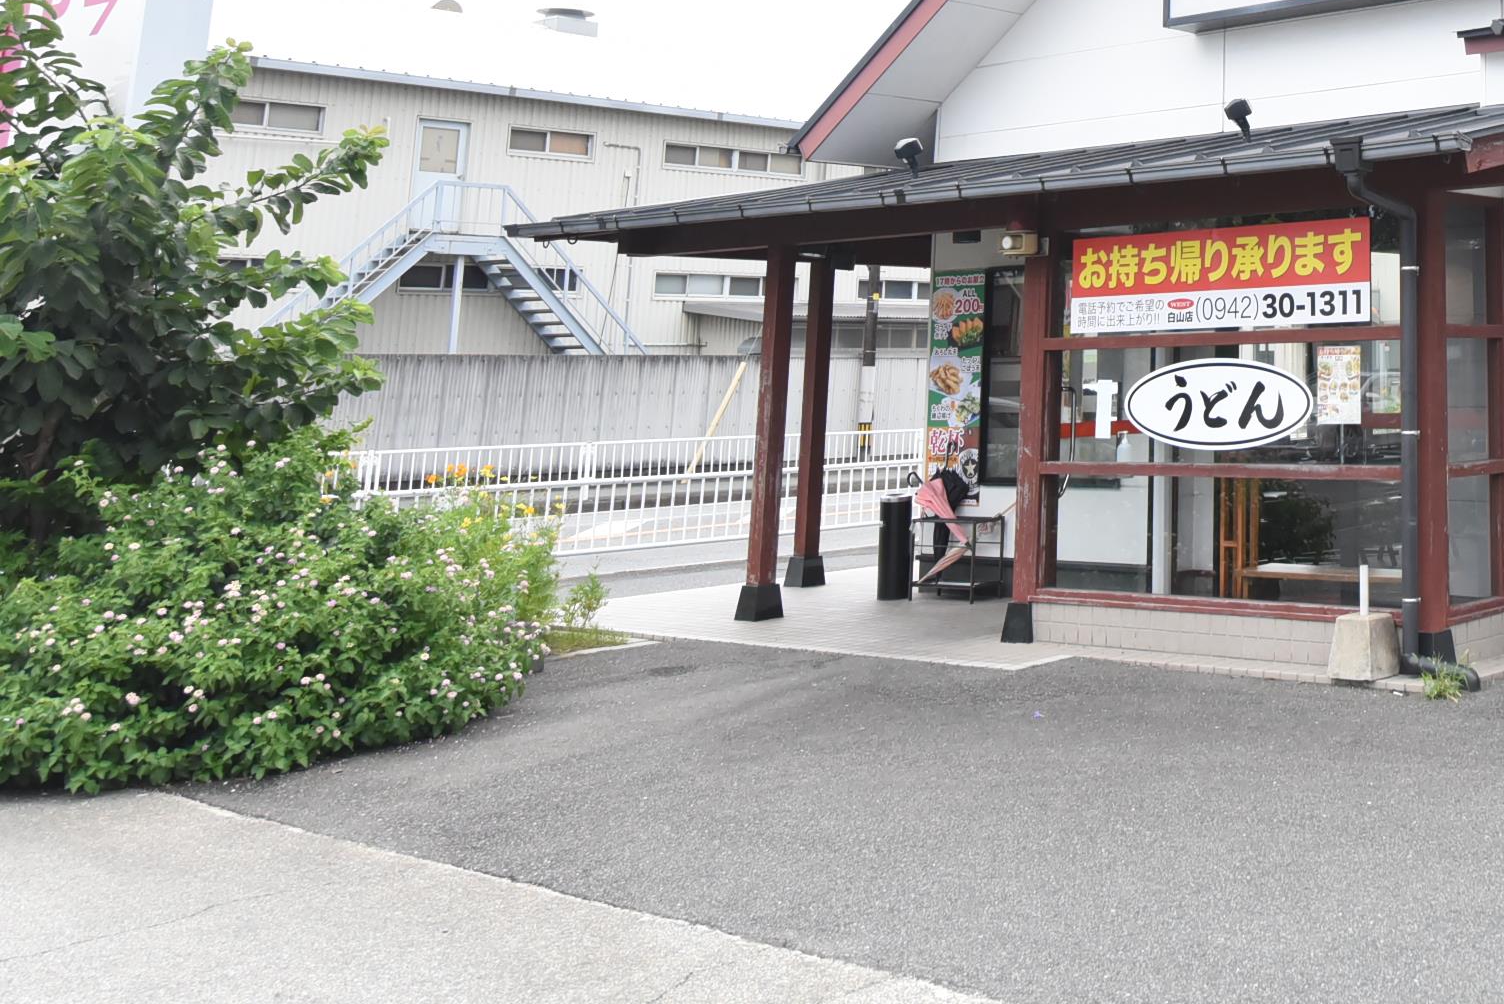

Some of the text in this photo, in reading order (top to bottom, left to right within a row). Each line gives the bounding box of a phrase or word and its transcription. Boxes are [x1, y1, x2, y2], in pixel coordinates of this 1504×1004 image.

[1077, 227, 1362, 290] お持ち帰り承ります
[962, 289, 976, 298] ALL
[1077, 298, 1165, 316] 電話予約でご希望の
[1167, 311, 1194, 323] 白山店
[1164, 374, 1285, 432] うどん
